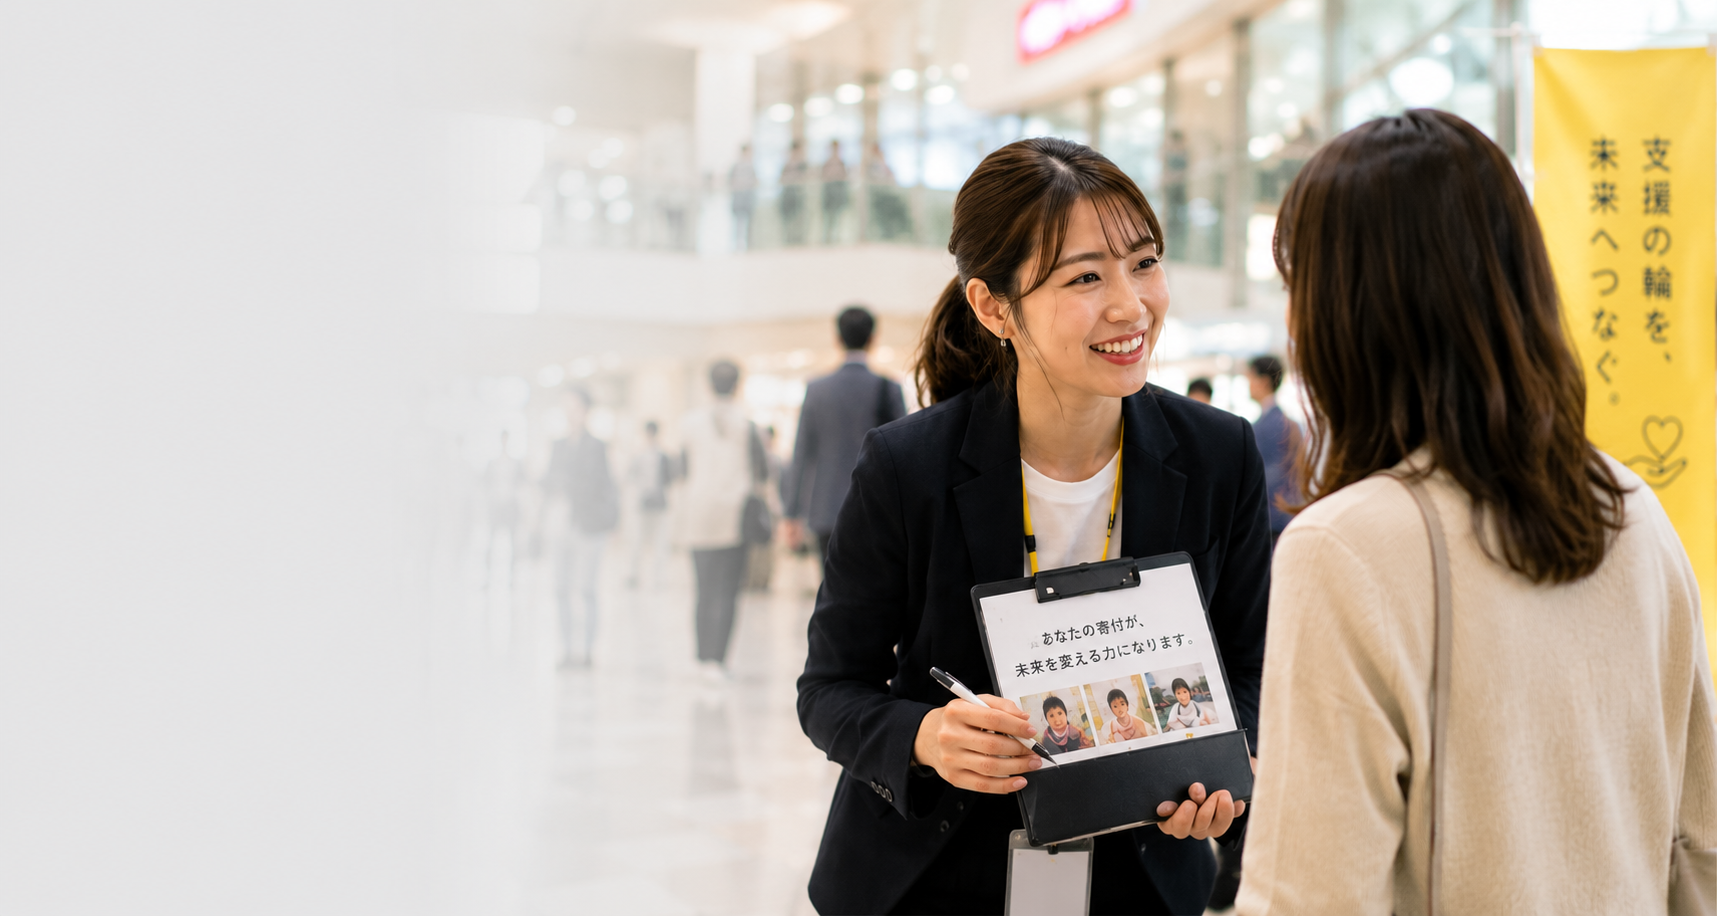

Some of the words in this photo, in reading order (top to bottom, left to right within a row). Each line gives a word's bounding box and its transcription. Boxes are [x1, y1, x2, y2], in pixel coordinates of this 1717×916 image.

[1590, 136, 1620, 405] 未来へつなぐ。
[1642, 136, 1673, 363] 支援の輪を、
[1015, 633, 1193, 678] 未来を変える力になります。
[1042, 615, 1145, 646] あなたの寄付が、
